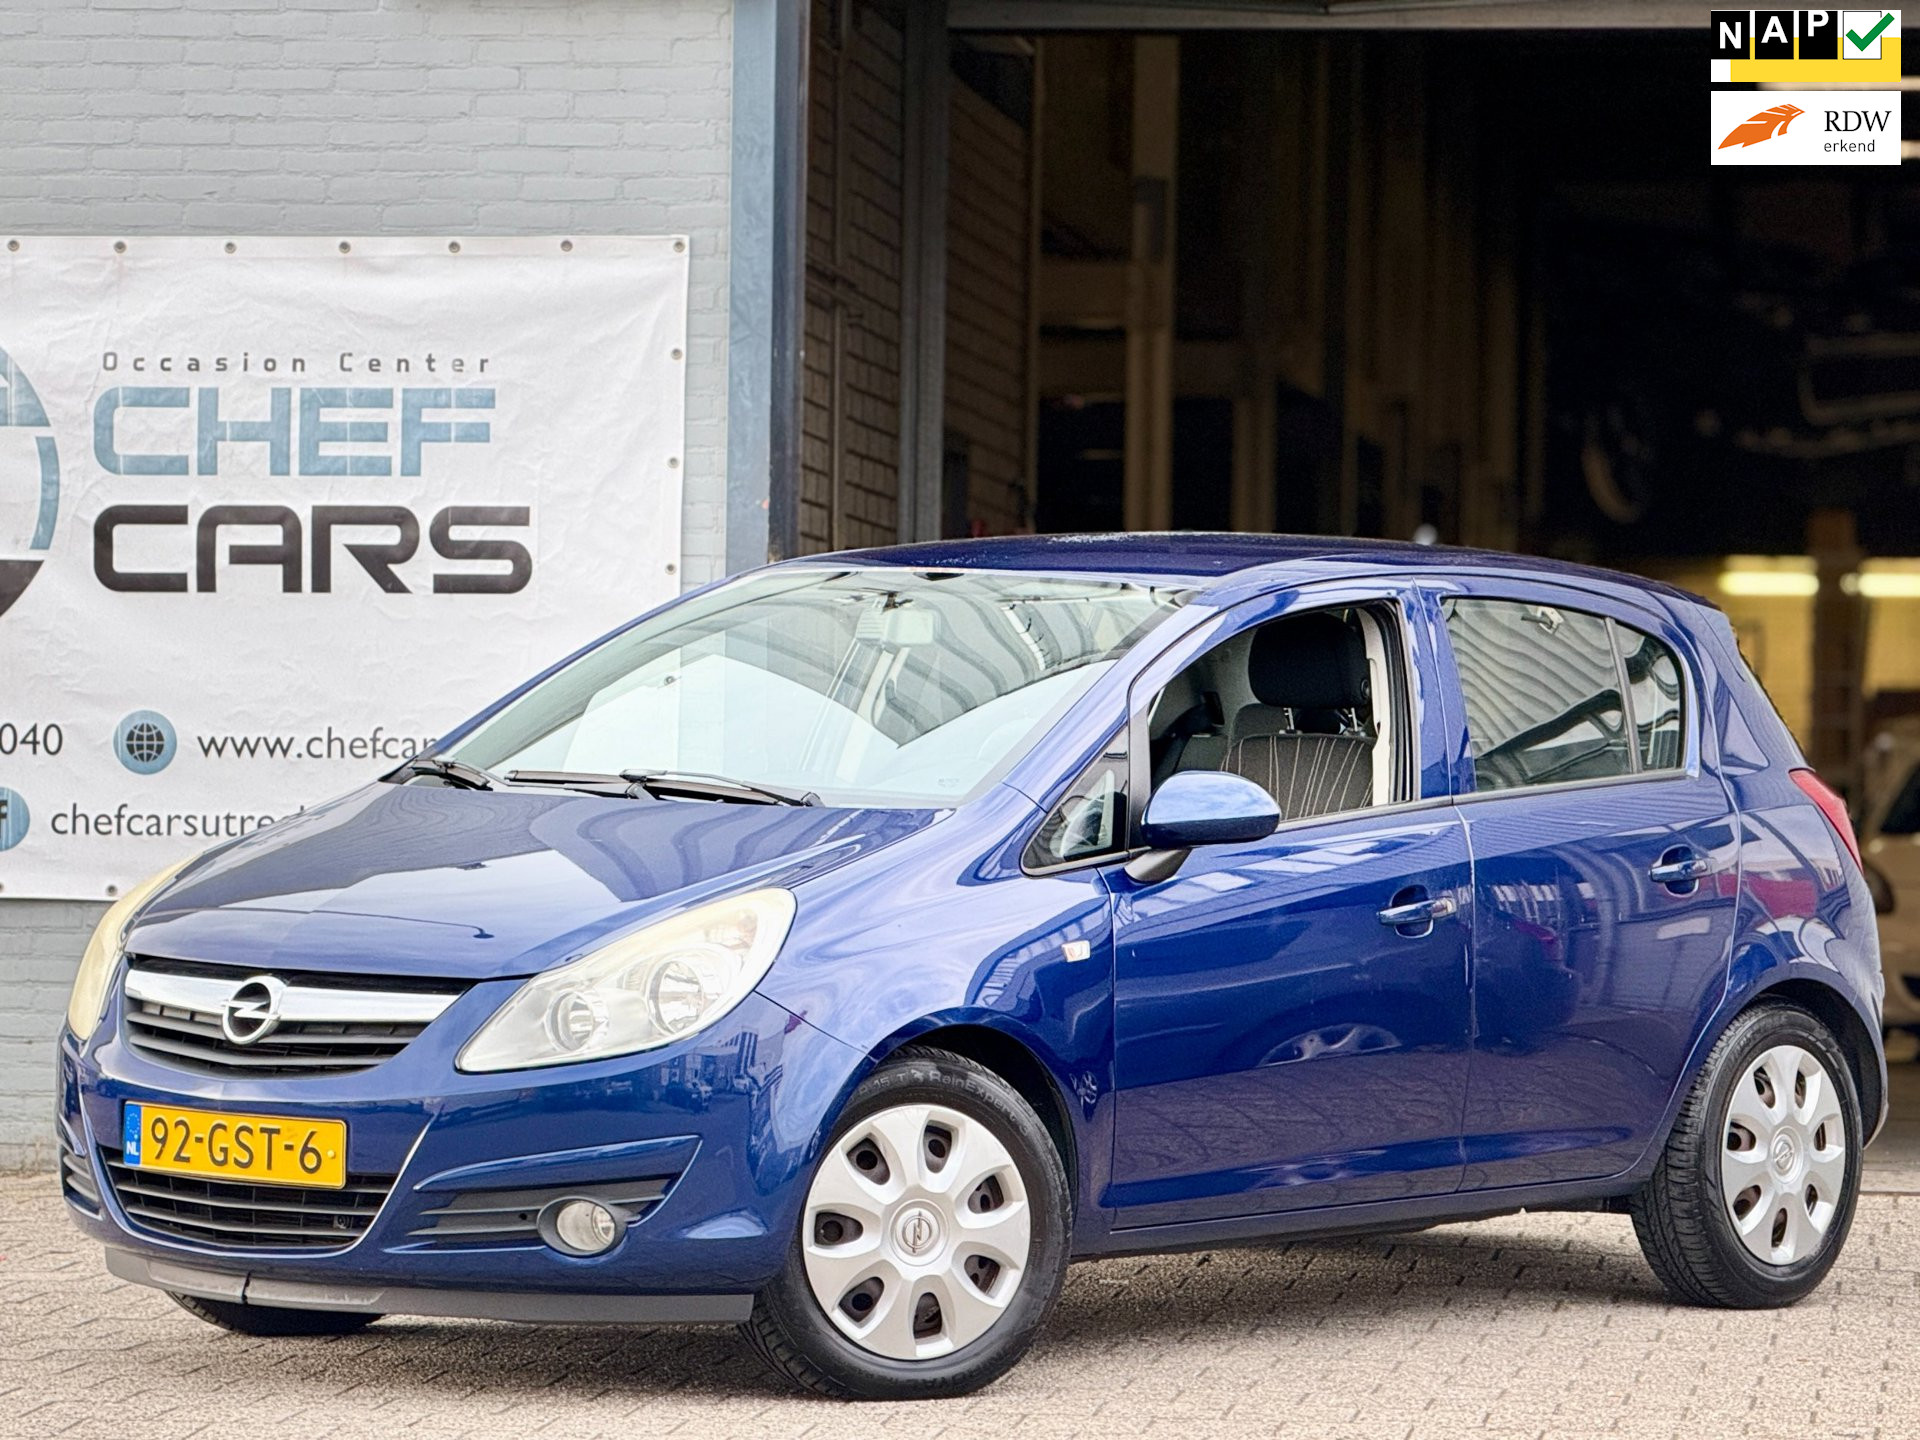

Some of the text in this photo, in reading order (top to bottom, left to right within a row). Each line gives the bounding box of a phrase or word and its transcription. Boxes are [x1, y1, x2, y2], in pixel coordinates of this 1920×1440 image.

[102, 351, 490, 373] Occasion Center
[94, 386, 495, 476] CHEF
[93, 504, 533, 594] CARS
[126, 1140, 139, 1156] NL
[150, 1116, 323, 1175] 92-GST-6
